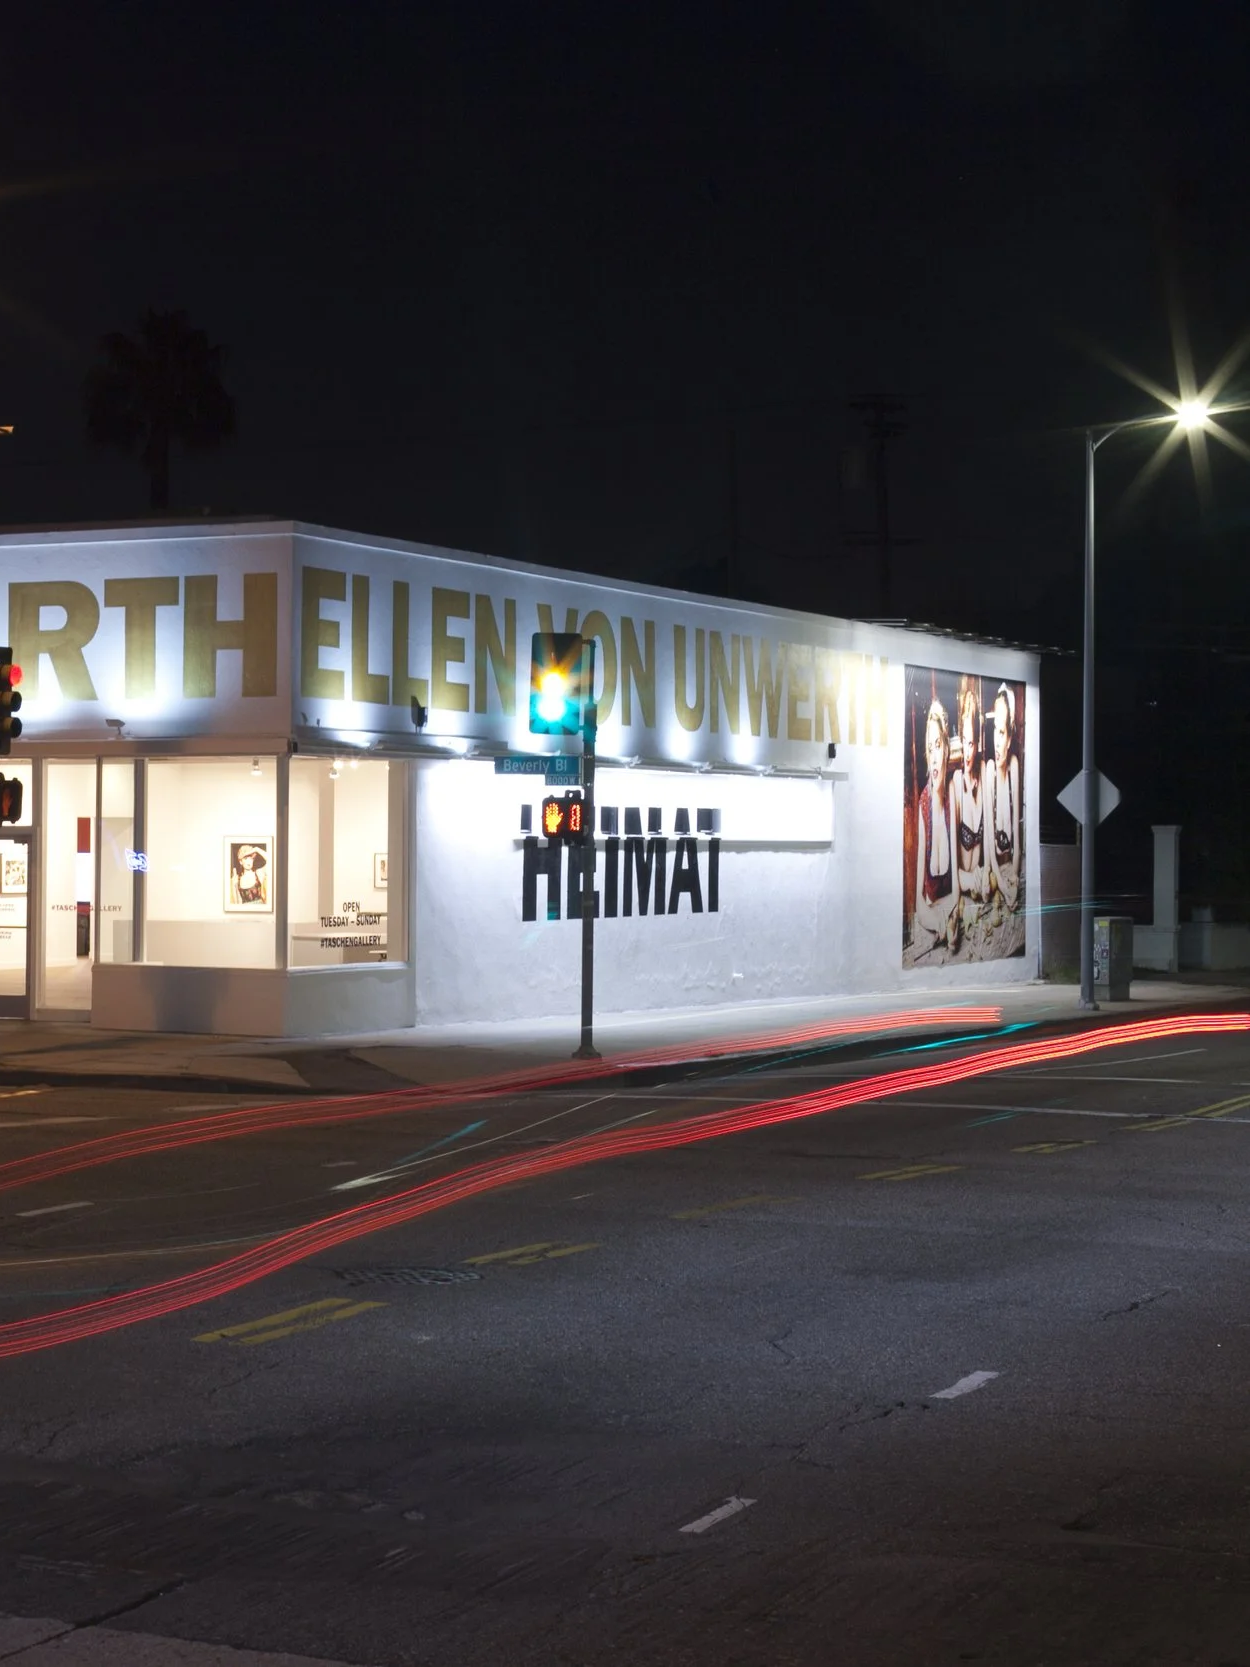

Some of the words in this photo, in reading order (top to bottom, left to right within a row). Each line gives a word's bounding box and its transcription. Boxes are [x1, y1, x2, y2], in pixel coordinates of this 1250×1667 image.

[301, 566, 517, 717] ELLEN
[536, 602, 655, 728] ON
[673, 623, 889, 747] UNWERTH
[503, 759, 550, 774] Beverly
[556, 759, 567, 772] Bl
[52, 904, 122, 912] #TASCHGLERY
[343, 901, 360, 912] OPEN
[321, 916, 349, 928] TUESDAY
[356, 914, 381, 926] SUNDAY
[321, 936, 381, 948] #TASCHENGALLERY
